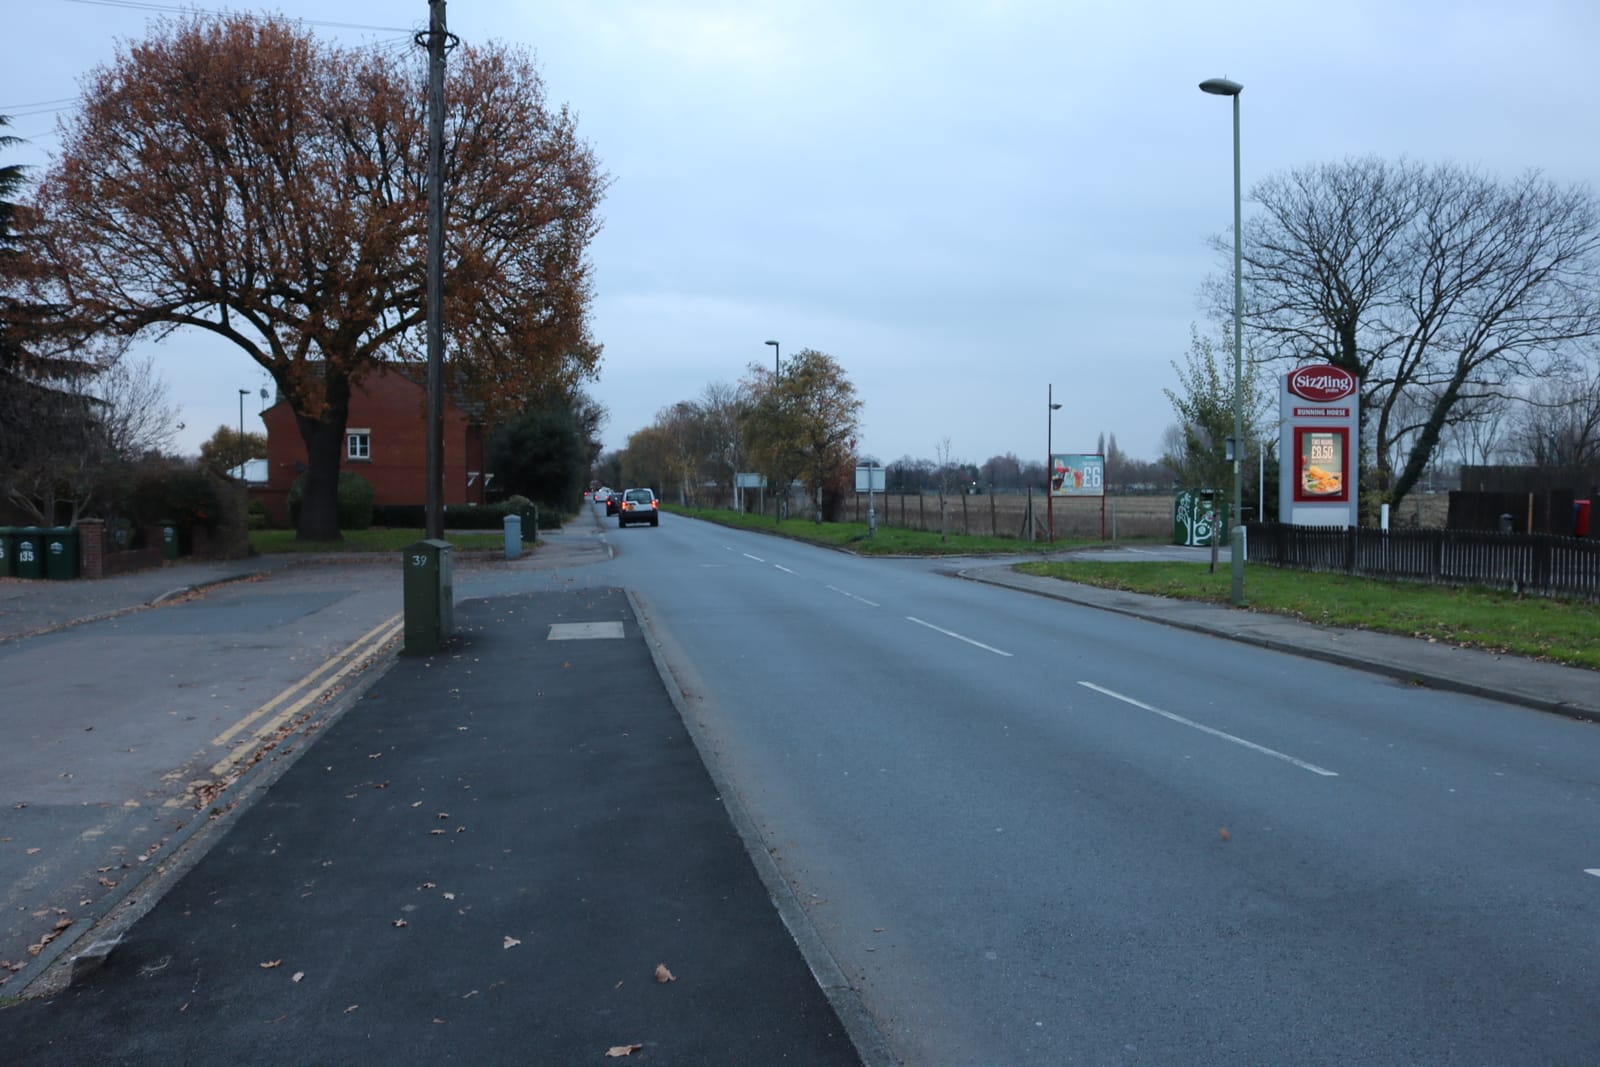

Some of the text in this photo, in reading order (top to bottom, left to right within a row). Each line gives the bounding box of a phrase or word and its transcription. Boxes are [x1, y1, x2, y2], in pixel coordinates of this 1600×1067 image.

[1297, 408, 1345, 416] RUNNING HORSE
[1312, 445, 1333, 459] £8.50
[1083, 466, 1101, 487] £6
[19, 551, 34, 561] 135
[411, 555, 427, 567] 39
